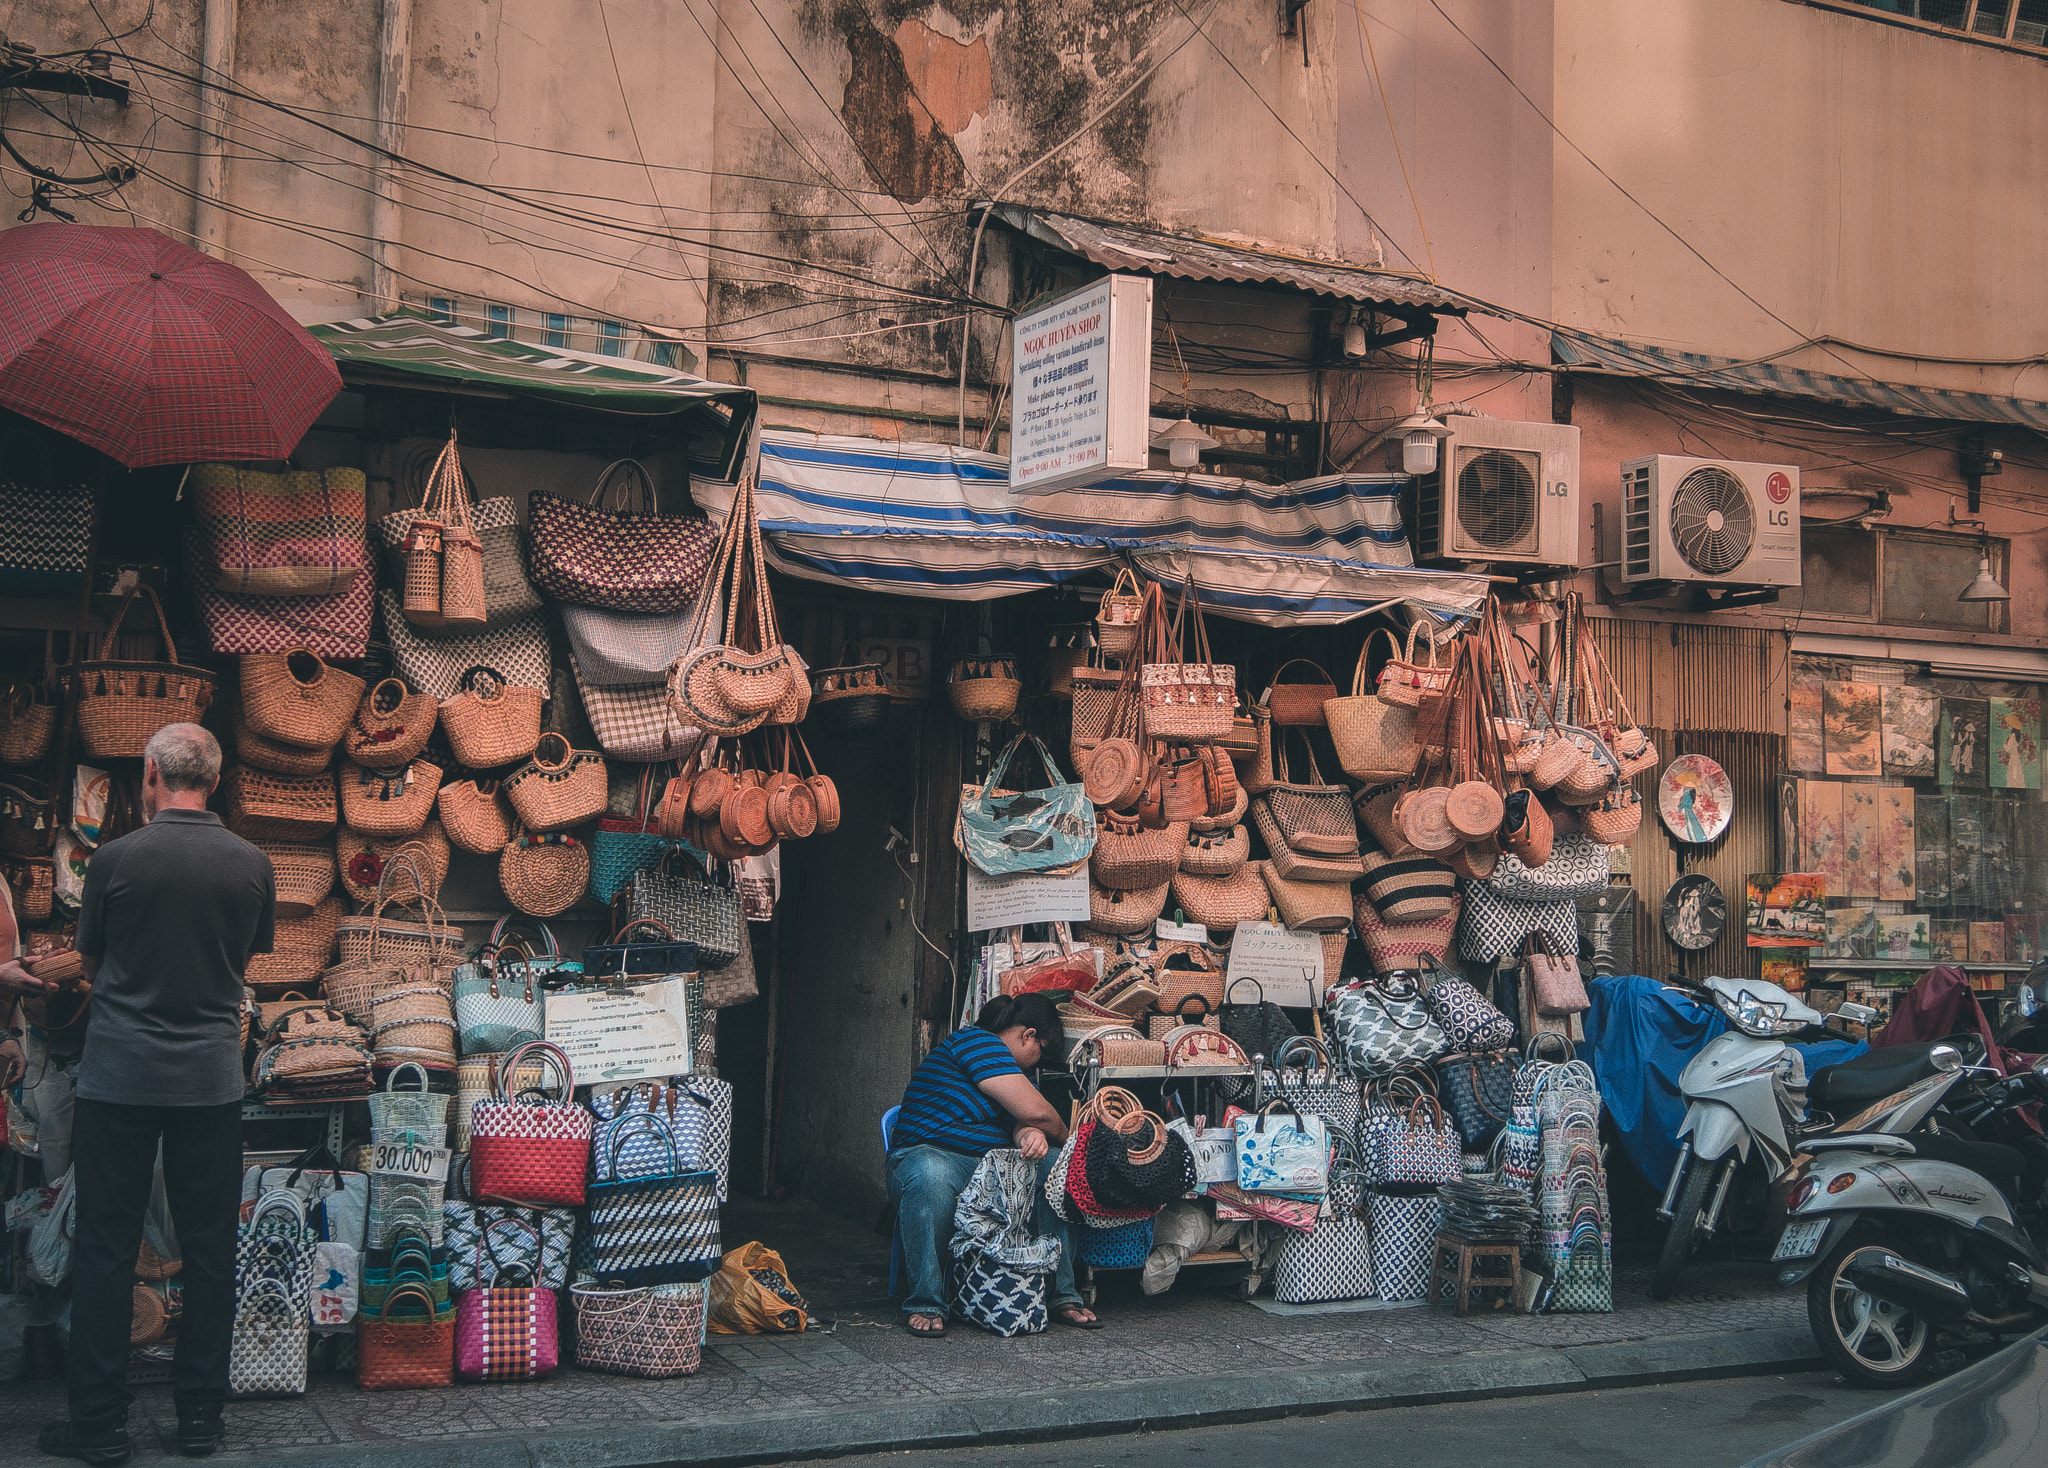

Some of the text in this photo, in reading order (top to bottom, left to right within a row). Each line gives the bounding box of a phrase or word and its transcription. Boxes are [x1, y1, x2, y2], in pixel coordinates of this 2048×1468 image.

[1024, 335, 1046, 355] NGỌC
[1079, 314, 1100, 333] SHOP
[1056, 348, 1070, 360] various
[1072, 338, 1092, 355] handicraft
[1094, 336, 1105, 347] items
[1028, 394, 1039, 404] Make
[1041, 390, 1055, 403] plastic
[1056, 387, 1066, 396] bags
[1074, 375, 1094, 390] required
[1019, 467, 1034, 479] Open
[1036, 461, 1048, 472] 9:00
[1049, 458, 1061, 469] AM
[1068, 451, 1085, 464] 21:00
[1087, 448, 1098, 459] PM
[1546, 480, 1568, 497] LG
[1768, 510, 1788, 526] LG
[376, 1145, 432, 1174] 30.000
[1210, 1144, 1232, 1154] VND
[1786, 1222, 1819, 1240] 59-T1
[1774, 1238, 1816, 1258] 268.42
